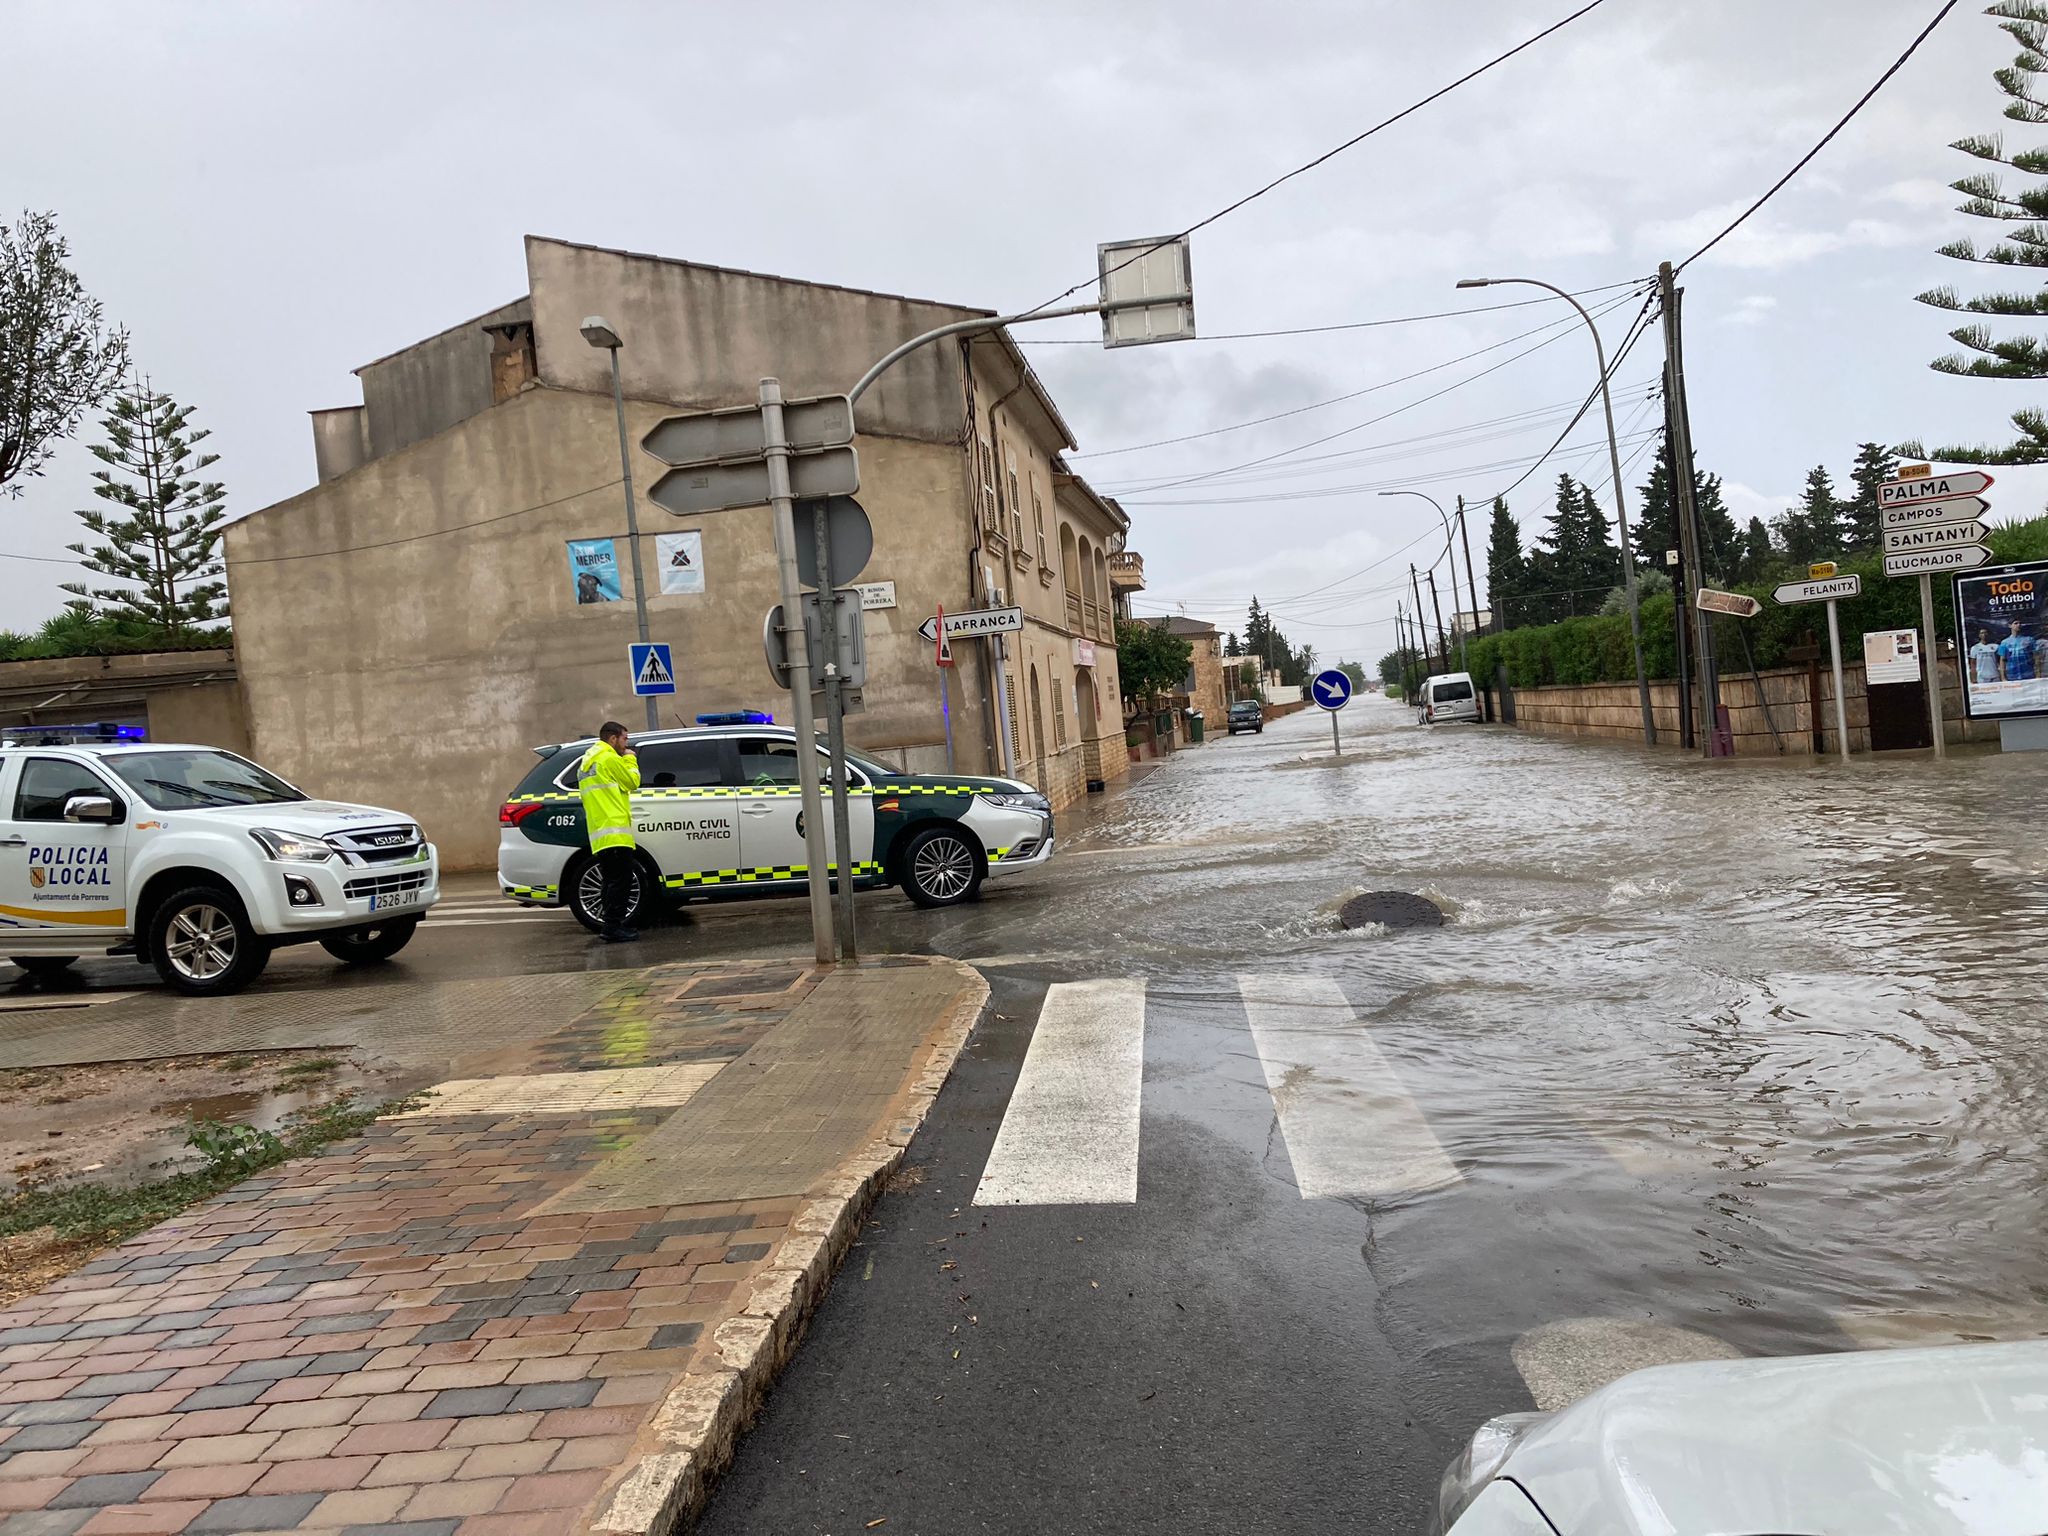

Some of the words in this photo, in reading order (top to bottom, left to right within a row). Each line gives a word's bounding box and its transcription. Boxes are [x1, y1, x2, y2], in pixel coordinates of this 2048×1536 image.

[1883, 480, 1950, 500] PALMA
[1888, 508, 1943, 522] CAMPOS
[1891, 524, 1974, 546] SANTANYÍ
[1888, 554, 1963, 570] LLUCMAJOR
[1803, 581, 1854, 596] FELANITX
[1987, 579, 2033, 594] Todo
[1989, 596, 1999, 605] el
[2001, 592, 2035, 604] fútbol
[934, 615, 1016, 632] LAFRANCA
[556, 815, 575, 826] 062
[638, 821, 695, 833] GUARDIA
[700, 819, 730, 829] CIVIL
[374, 835, 405, 846] ISUZU
[28, 847, 108, 865] POLICIA
[49, 867, 111, 885] LOCAL
[33, 893, 71, 902] Ajuntament
[377, 894, 400, 909] 2526
[403, 891, 419, 904] JYV
